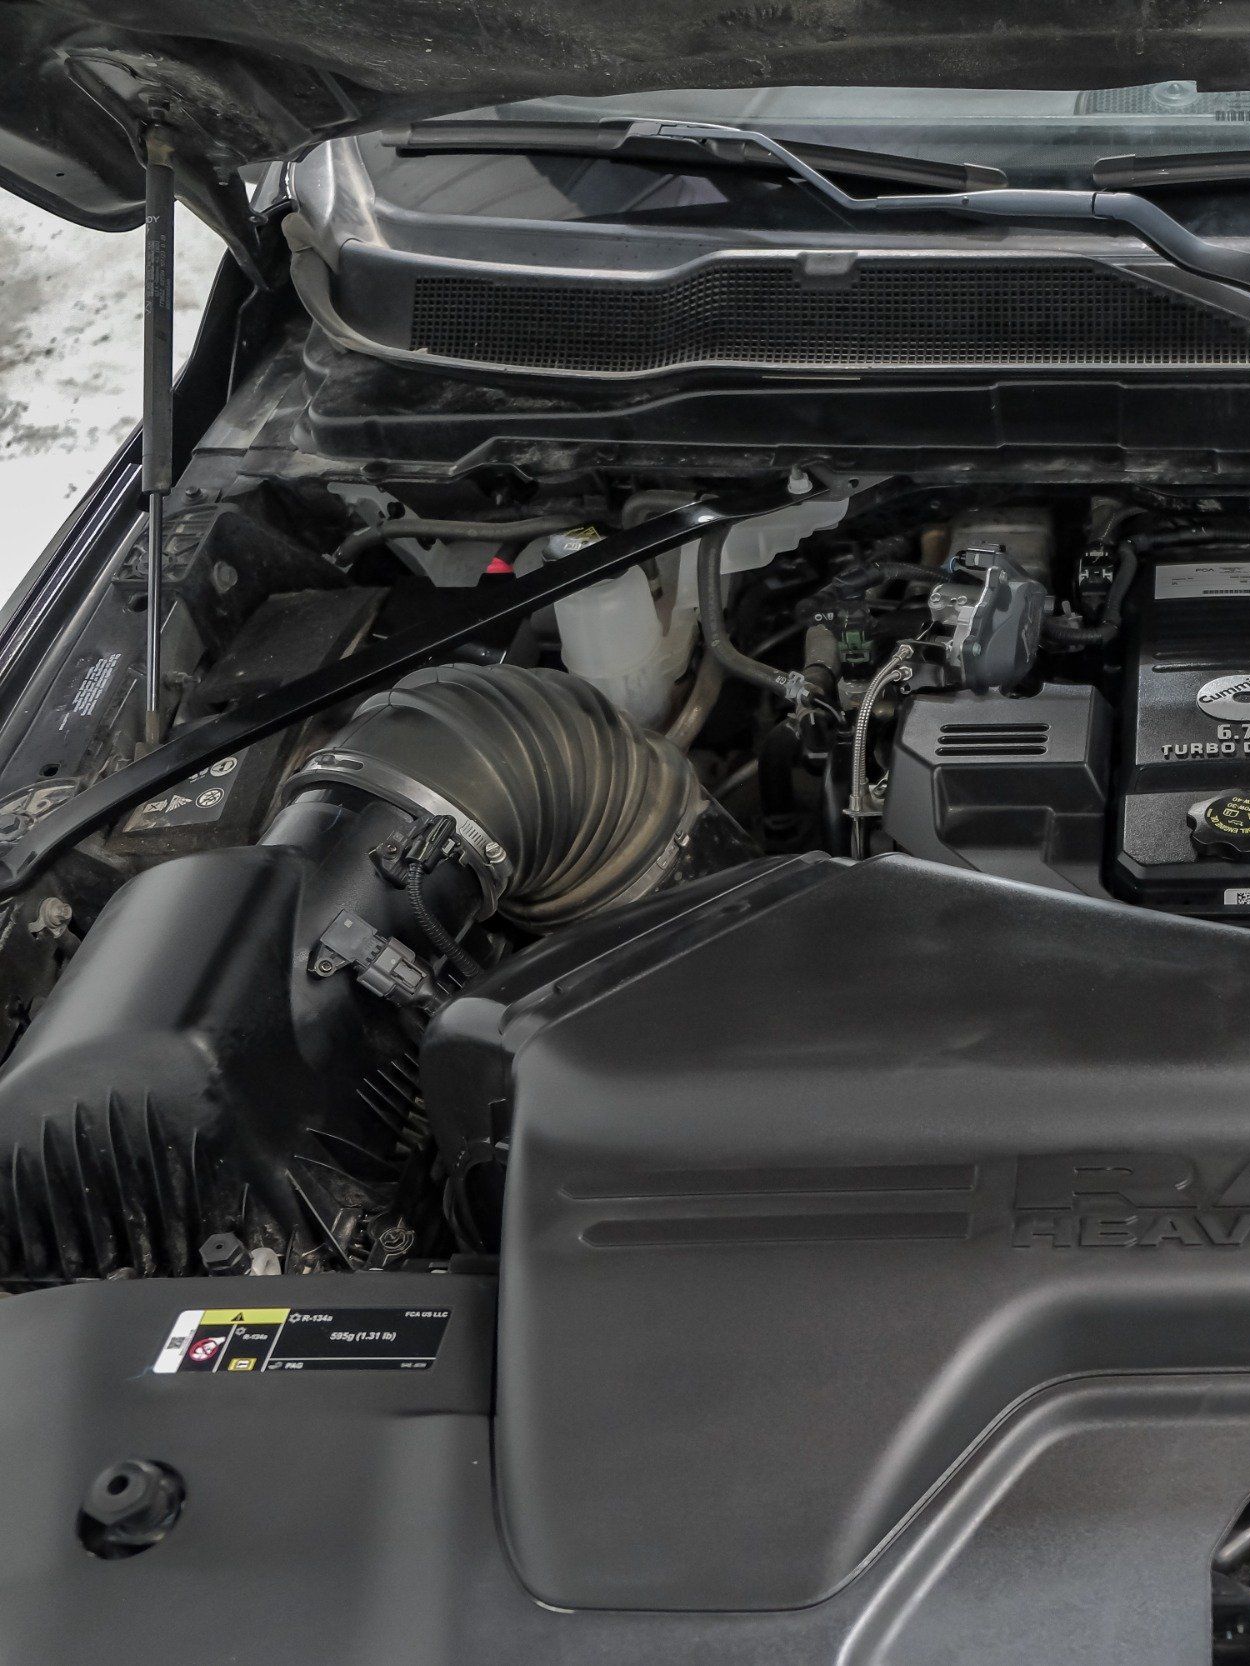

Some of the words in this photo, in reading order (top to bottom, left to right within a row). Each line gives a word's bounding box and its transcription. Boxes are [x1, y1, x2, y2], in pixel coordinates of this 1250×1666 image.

[1161, 742, 1236, 756] TURBO
[301, 1314, 334, 1322] R-134a
[329, 1331, 355, 1342] 595g
[355, 1331, 380, 1342] (1.31
[381, 1331, 397, 1342] lb)
